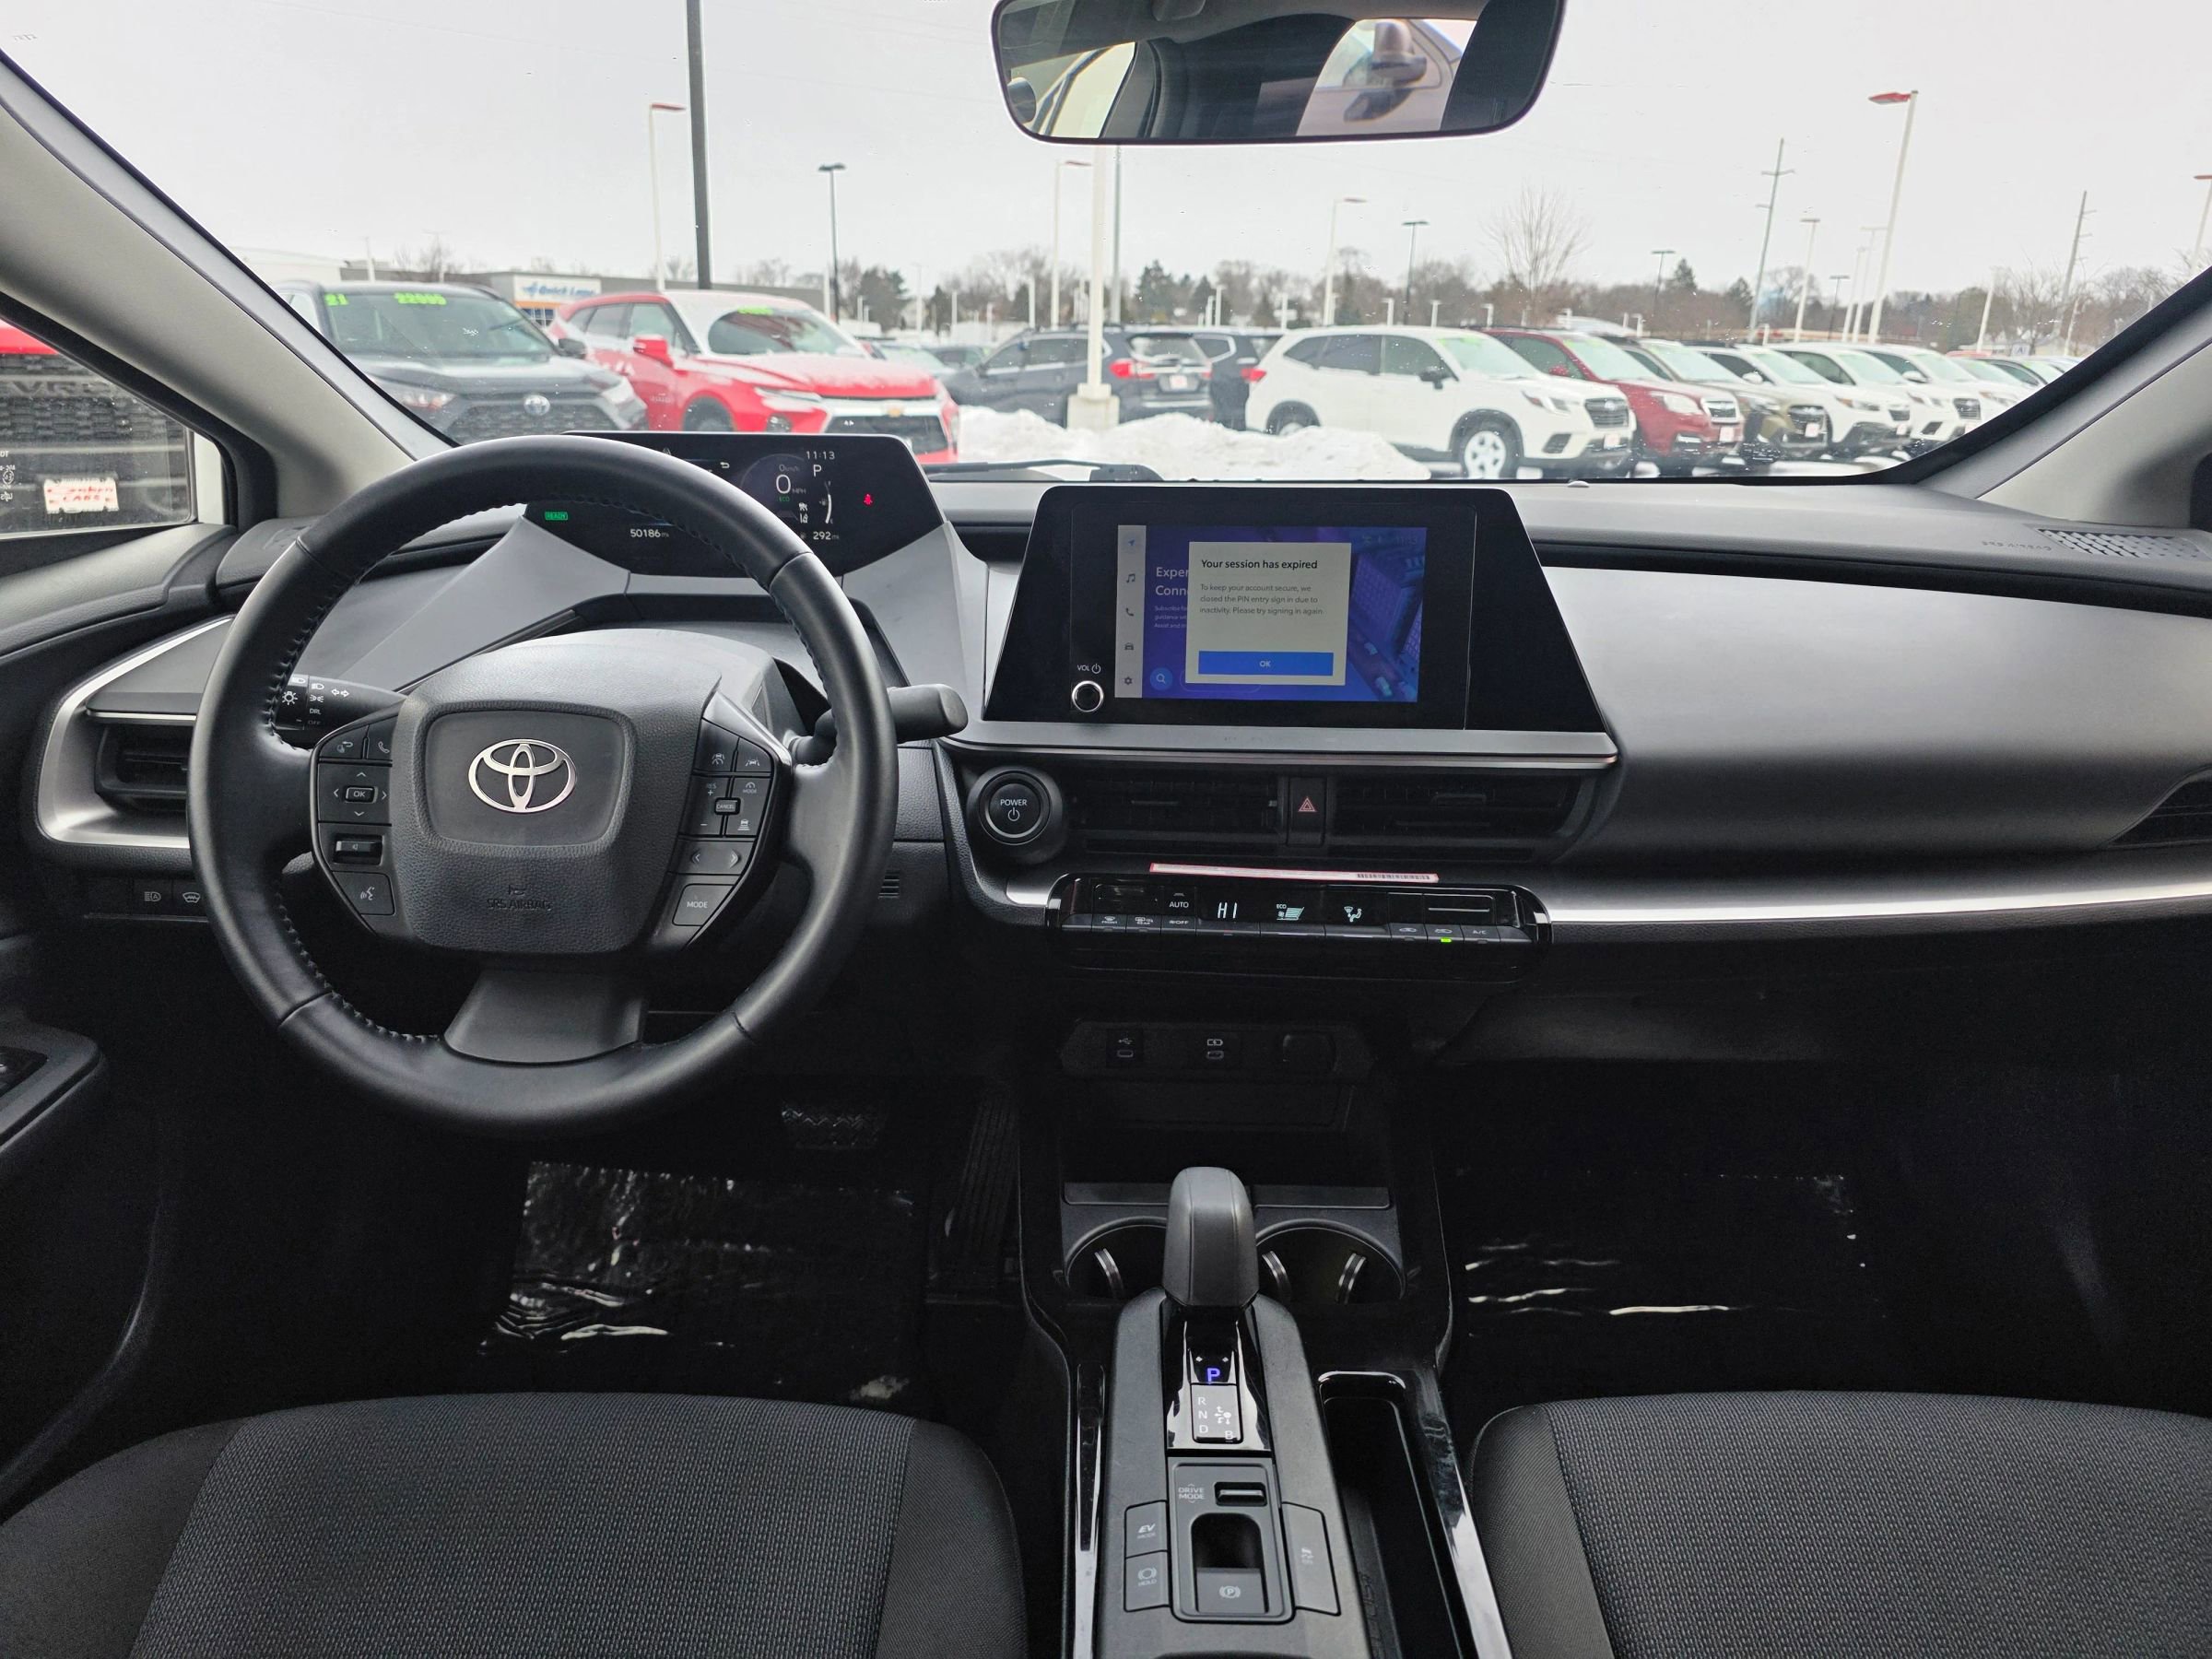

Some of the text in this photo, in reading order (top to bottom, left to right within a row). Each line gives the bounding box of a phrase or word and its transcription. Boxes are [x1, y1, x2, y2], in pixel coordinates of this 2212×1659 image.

[806, 451, 835, 460] 11:13
[813, 465, 822, 477] P
[629, 528, 661, 538] 50186
[813, 531, 831, 540] 292
[1201, 559, 1318, 571] Your session has expired
[1251, 596, 1269, 605] entry
[1270, 595, 1286, 605] sign
[1256, 607, 1266, 616] try
[1267, 607, 1293, 616] signing
[1206, 1367, 1221, 1384] P
[1197, 1396, 1206, 1406] R
[1197, 1410, 1208, 1419] N
[1199, 1424, 1209, 1434] D
[1224, 1430, 1234, 1440] B
[1137, 1524, 1156, 1534] EV
